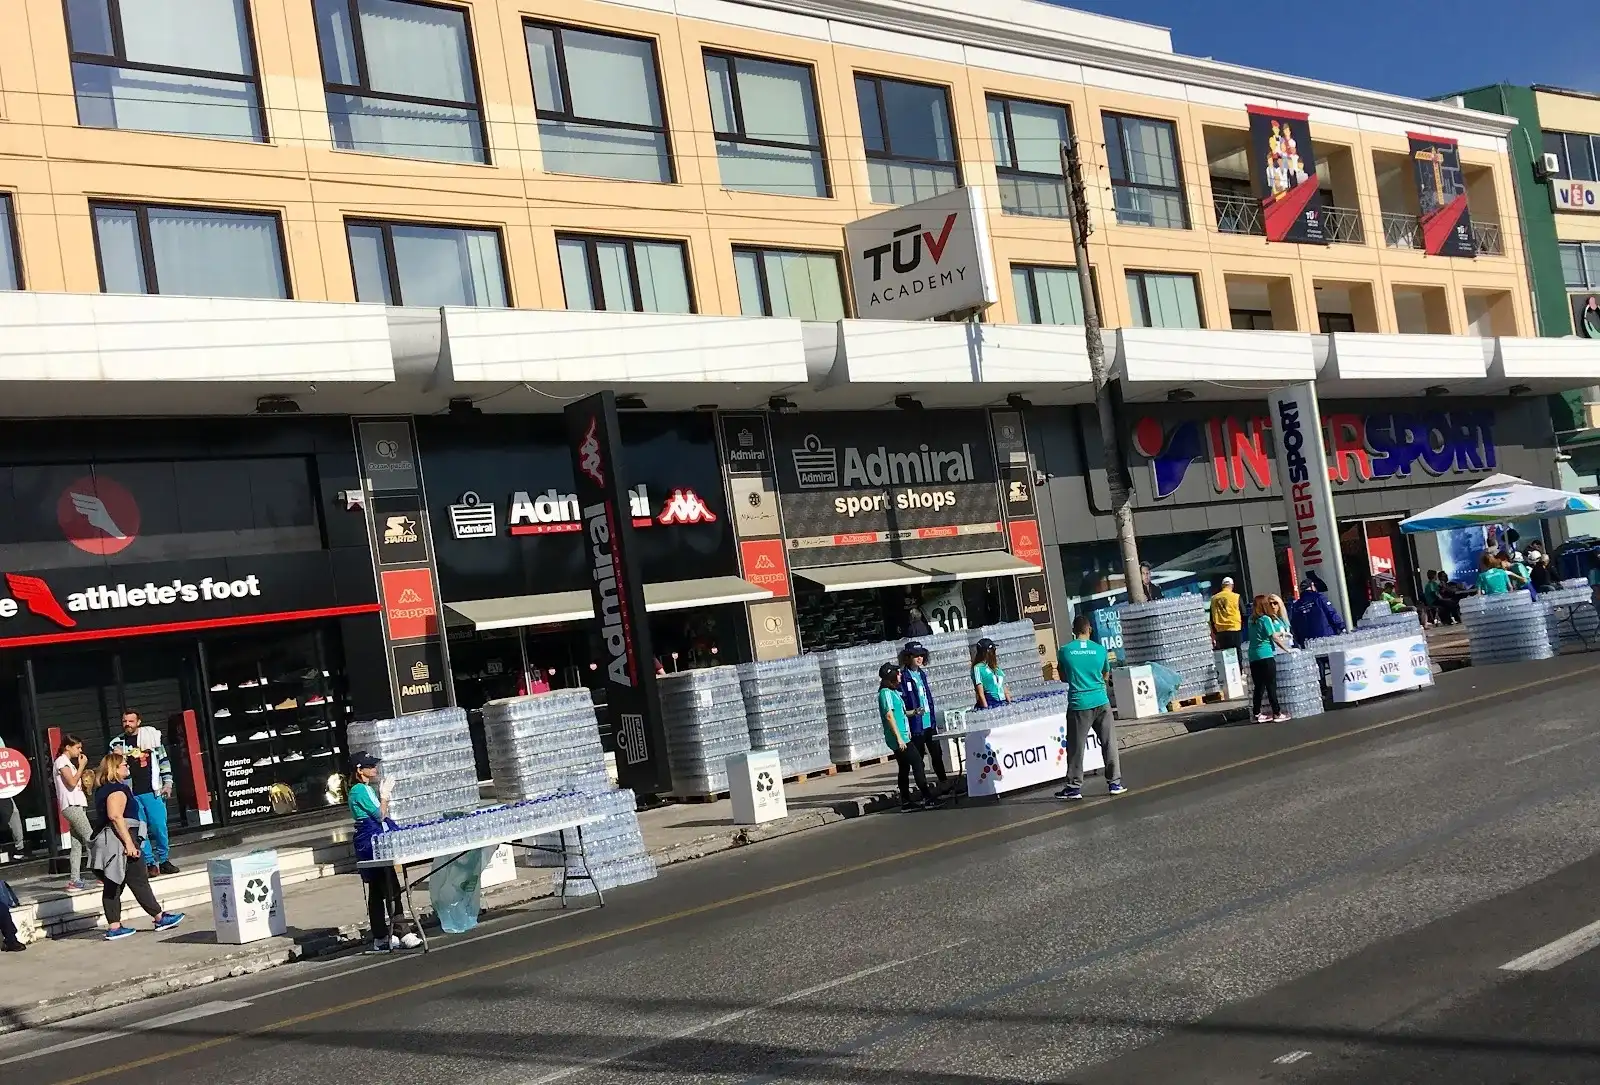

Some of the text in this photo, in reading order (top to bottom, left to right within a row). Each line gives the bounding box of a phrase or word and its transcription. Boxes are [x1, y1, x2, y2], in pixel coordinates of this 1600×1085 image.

[870, 266, 966, 306] ACADEMY
[731, 449, 765, 460] Admiral
[1205, 411, 1497, 490] INRSPORT
[843, 443, 975, 487] Admiral
[801, 471, 835, 484] Admiral
[1278, 400, 1323, 566] INTERSPORT
[834, 488, 956, 517] sport shops
[458, 523, 493, 535] Admiral
[537, 524, 582, 533] SPORT
[384, 534, 418, 545] STARTER
[748, 573, 785, 584] Kappa
[67, 579, 199, 612] athlete's
[200, 574, 261, 601] foot
[584, 502, 631, 687] Admiral
[389, 607, 433, 619] Kappa
[1024, 603, 1048, 614] Admiral
[1096, 608, 1120, 622] Έχου
[1101, 635, 1123, 649] ΠΑΘ
[401, 681, 443, 697] Admiral
[635, 718, 646, 758] Admiral
[0, 760, 20, 770] SON
[224, 758, 251, 767] Atlanta
[0, 768, 26, 786] ALE
[225, 767, 254, 777] Chicago
[227, 778, 249, 787] Miami
[228, 785, 273, 797] Copenhagen
[229, 798, 253, 807] Lisbon
[231, 805, 271, 817] Mexico City
